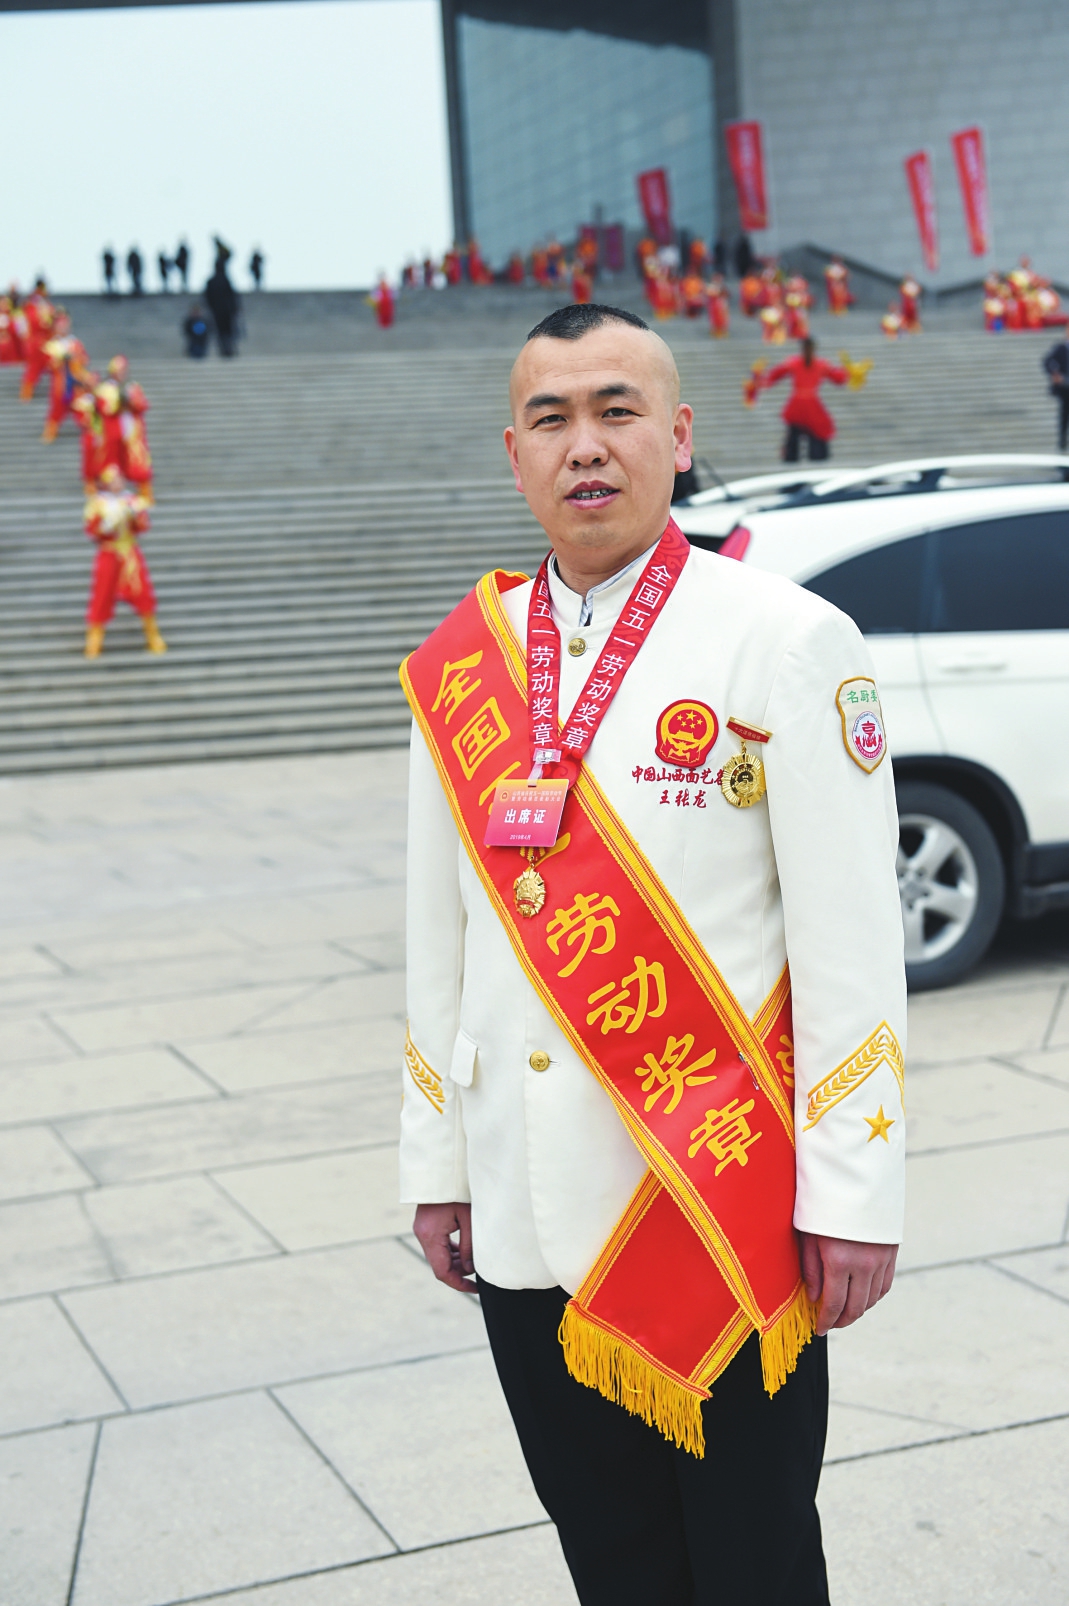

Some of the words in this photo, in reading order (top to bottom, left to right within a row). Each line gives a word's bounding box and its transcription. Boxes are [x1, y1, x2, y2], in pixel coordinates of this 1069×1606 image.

[531, 574, 555, 746] 国五一劳动奖章
[561, 564, 673, 749] 全国五一劳动奖章
[504, 808, 547, 825] 出席证
